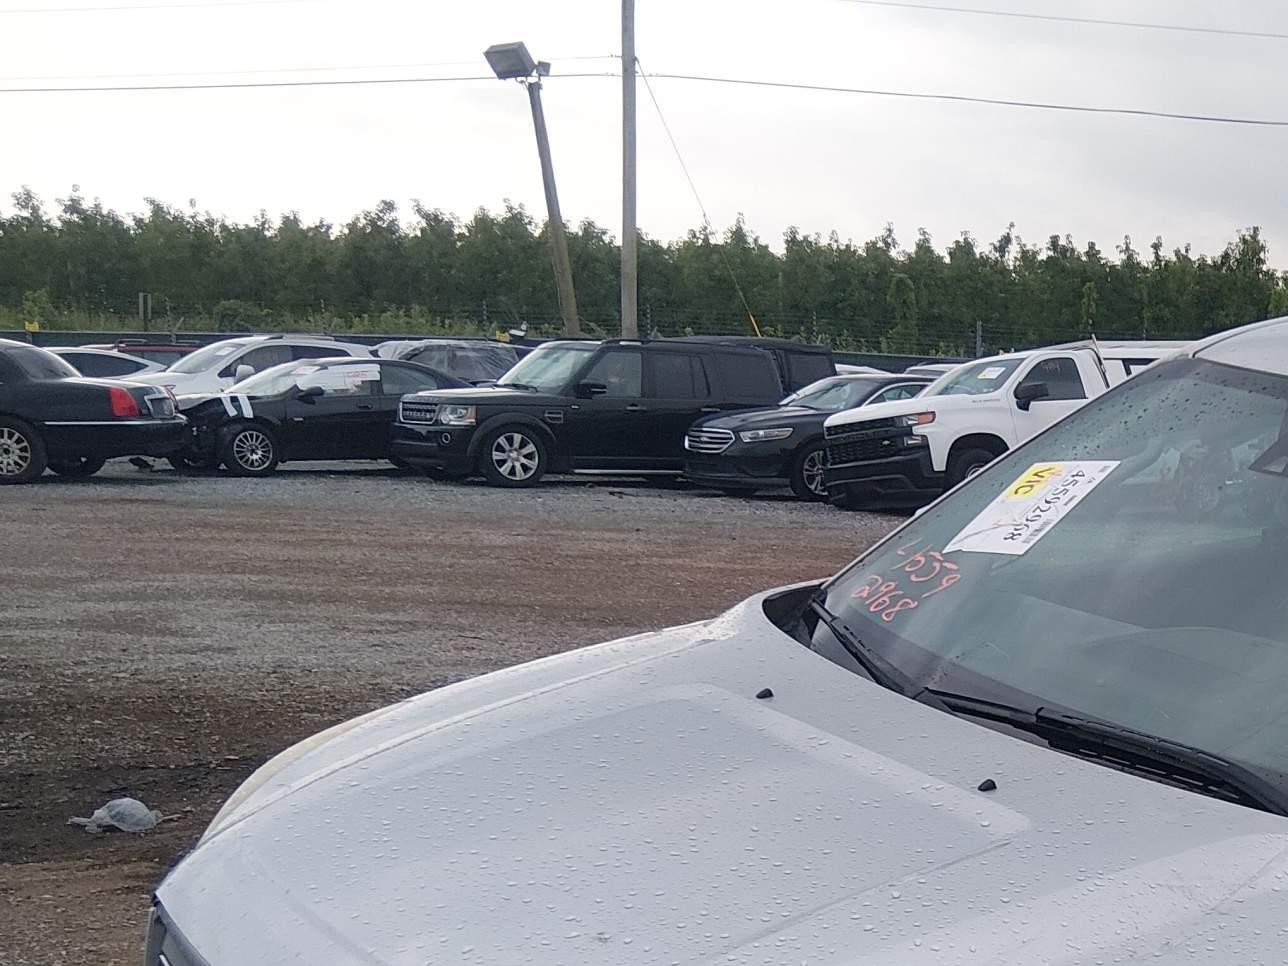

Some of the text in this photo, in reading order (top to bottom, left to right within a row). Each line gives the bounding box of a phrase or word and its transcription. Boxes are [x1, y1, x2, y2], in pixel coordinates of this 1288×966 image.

[1013, 466, 1055, 496] VIC
[1003, 469, 1086, 541] 45592968
[851, 575, 919, 622] 2968
